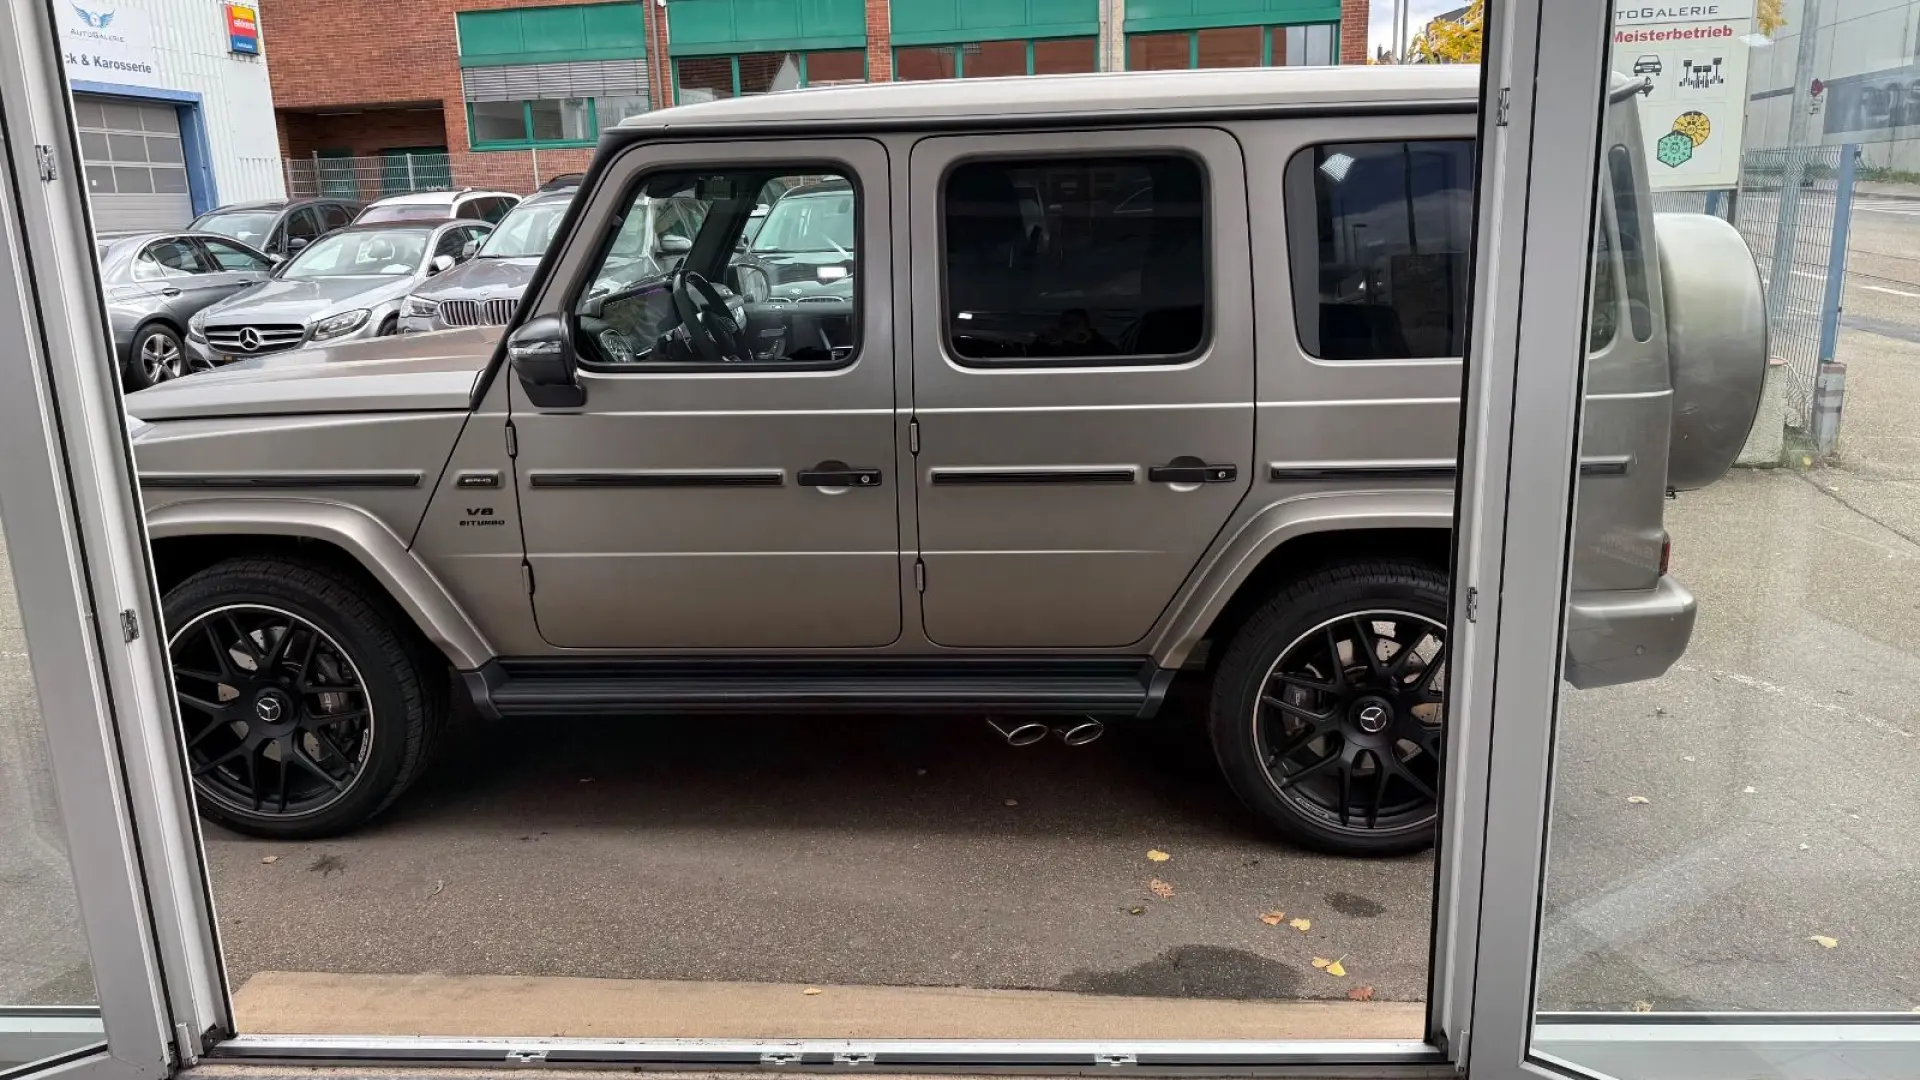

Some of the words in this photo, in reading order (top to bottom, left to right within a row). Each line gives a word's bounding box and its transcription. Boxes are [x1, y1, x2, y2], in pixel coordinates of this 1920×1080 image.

[1614, 25, 1733, 42] Meisterbetrieb
[81, 53, 90, 65] &
[93, 55, 152, 74] Karosserie
